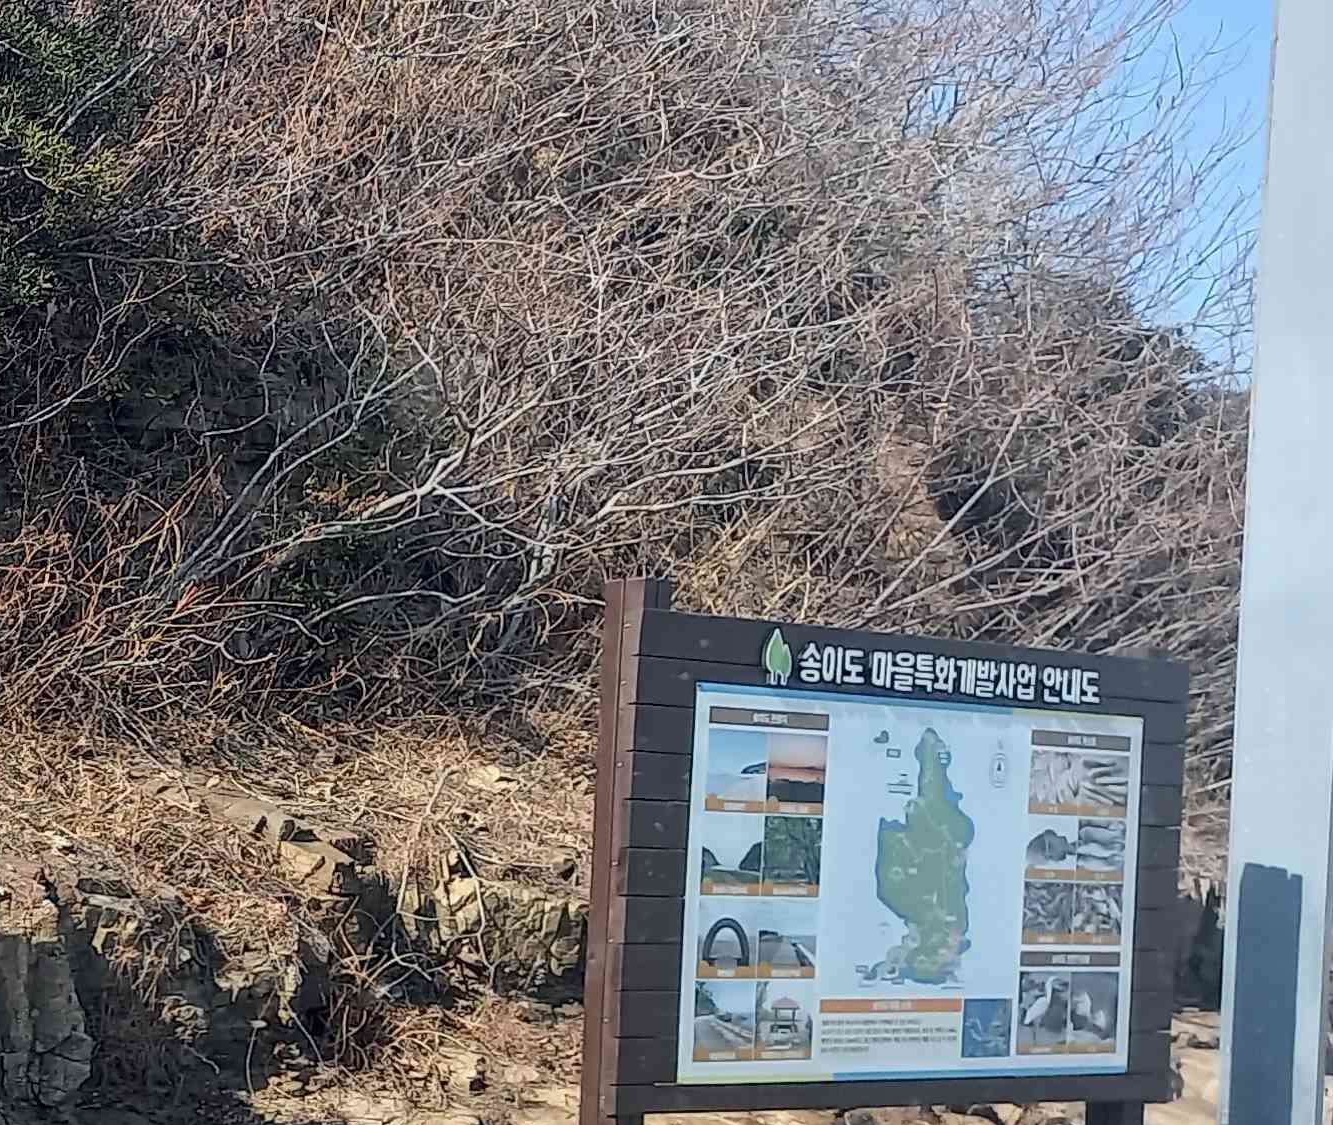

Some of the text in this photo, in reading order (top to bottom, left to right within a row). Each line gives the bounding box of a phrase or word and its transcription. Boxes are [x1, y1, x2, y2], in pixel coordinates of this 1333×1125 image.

[798, 642, 1101, 705] 송이도 마을특화개발사업 안내도
